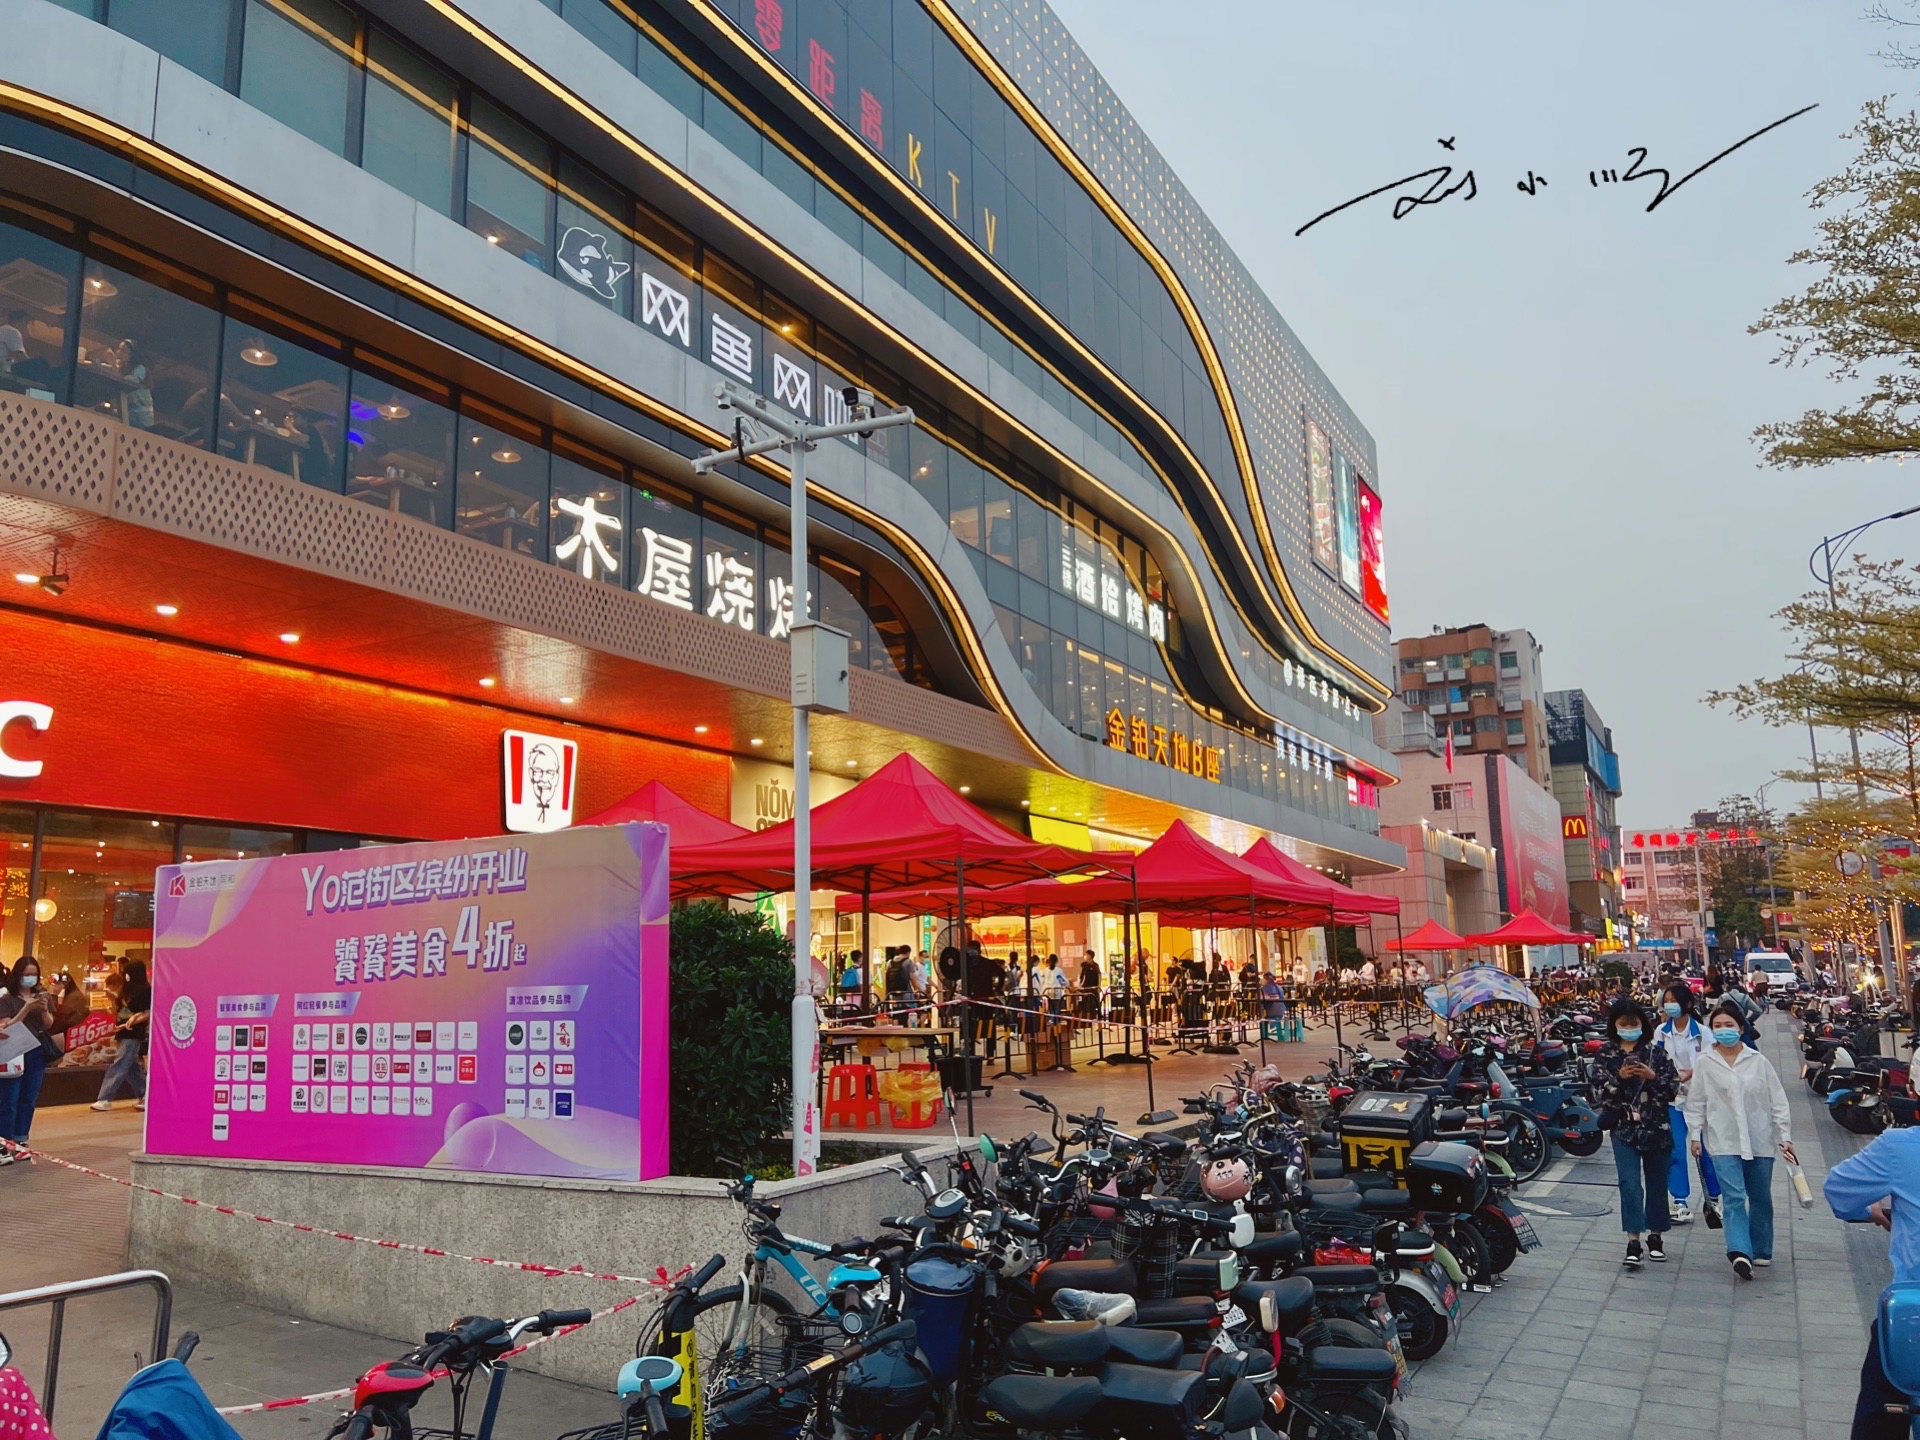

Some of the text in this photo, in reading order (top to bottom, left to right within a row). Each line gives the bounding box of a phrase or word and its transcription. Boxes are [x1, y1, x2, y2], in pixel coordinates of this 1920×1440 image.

[1105, 707, 1221, 784] 金铂天地B座
[301, 847, 528, 915] Yo范街区缤纷开业
